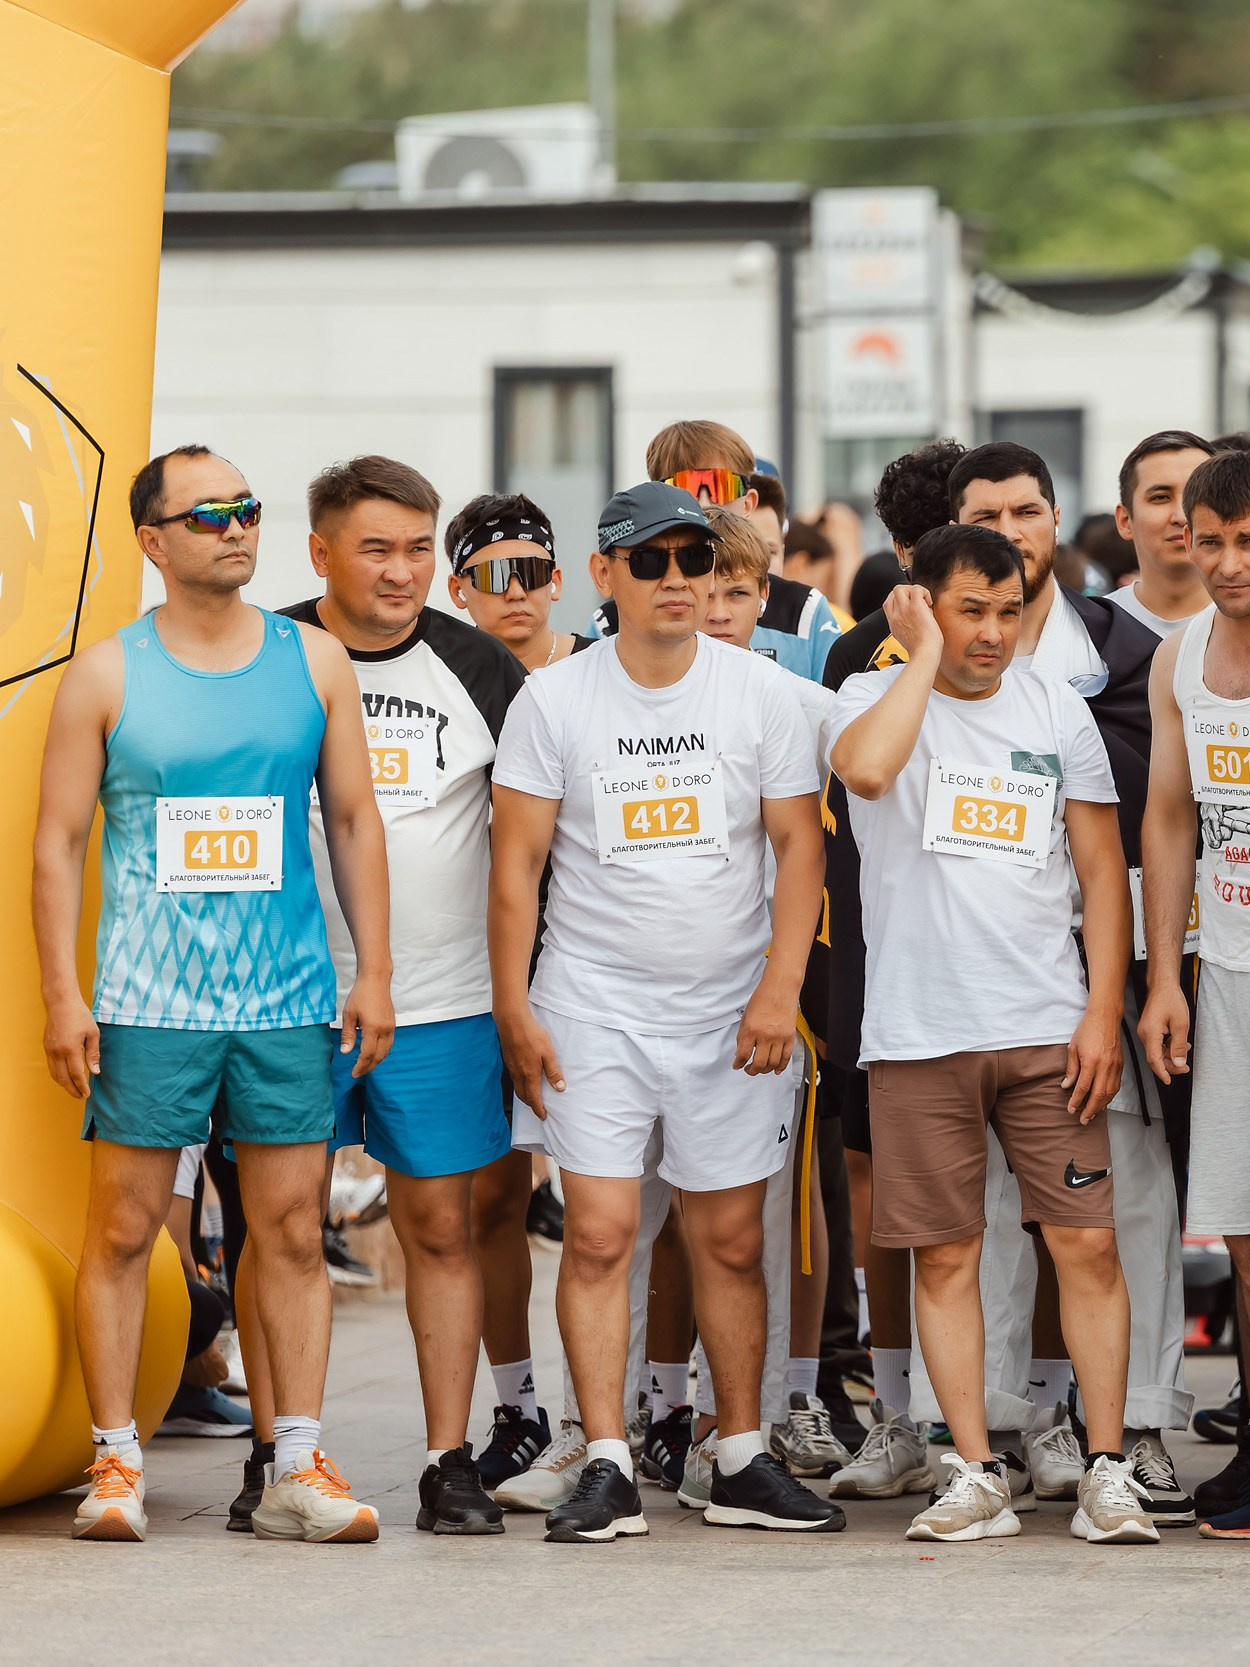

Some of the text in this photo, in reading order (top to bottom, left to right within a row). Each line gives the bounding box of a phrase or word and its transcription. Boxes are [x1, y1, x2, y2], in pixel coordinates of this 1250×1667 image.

[385, 728, 424, 740] D'ORO
[1194, 722, 1225, 736] LEONE
[617, 733, 705, 755] NAIMAN
[369, 752, 401, 780] 35
[401, 789, 423, 797] ЗАБЕГ
[604, 774, 712, 794] LEONE D'ORO
[940, 772, 1044, 798] LEONE D'ORO
[168, 808, 273, 821] LEONE D'ORO
[631, 801, 692, 833] 412
[960, 801, 1018, 836] 334
[190, 835, 251, 864] 410
[611, 837, 716, 853] БЛАГОТВОРИТЕЛЬНЫЙ ЗАБЕГ
[935, 835, 1036, 857] БЛАГОТВОРИТЕЛЬНЫЙ ЗАБЕГ
[169, 873, 270, 882] БЛАГОТВОРИТЕЛЬНЫЙ ЗАБЕГ
